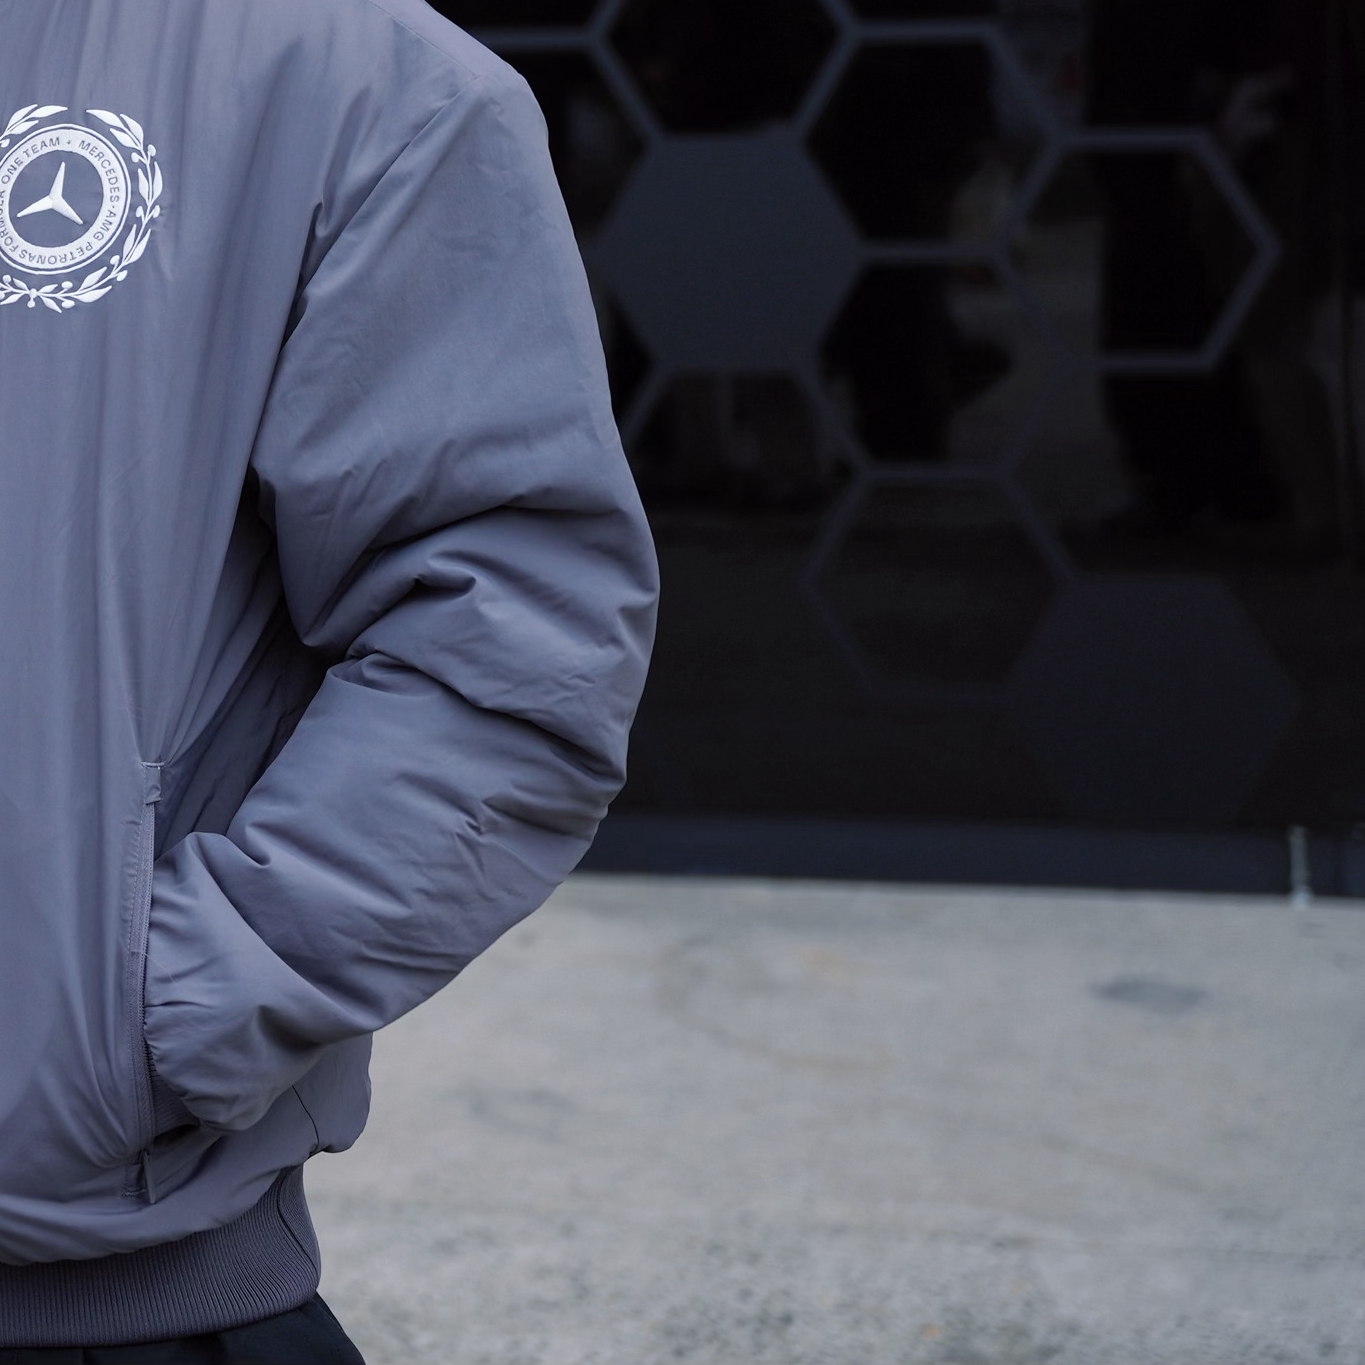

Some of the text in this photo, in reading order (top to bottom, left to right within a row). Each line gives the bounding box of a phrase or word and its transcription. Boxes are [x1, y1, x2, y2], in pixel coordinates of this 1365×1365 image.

[23, 136, 60, 158] TEAM
[2, 157, 24, 185] ONE
[18, 241, 94, 265] PETRONAS
